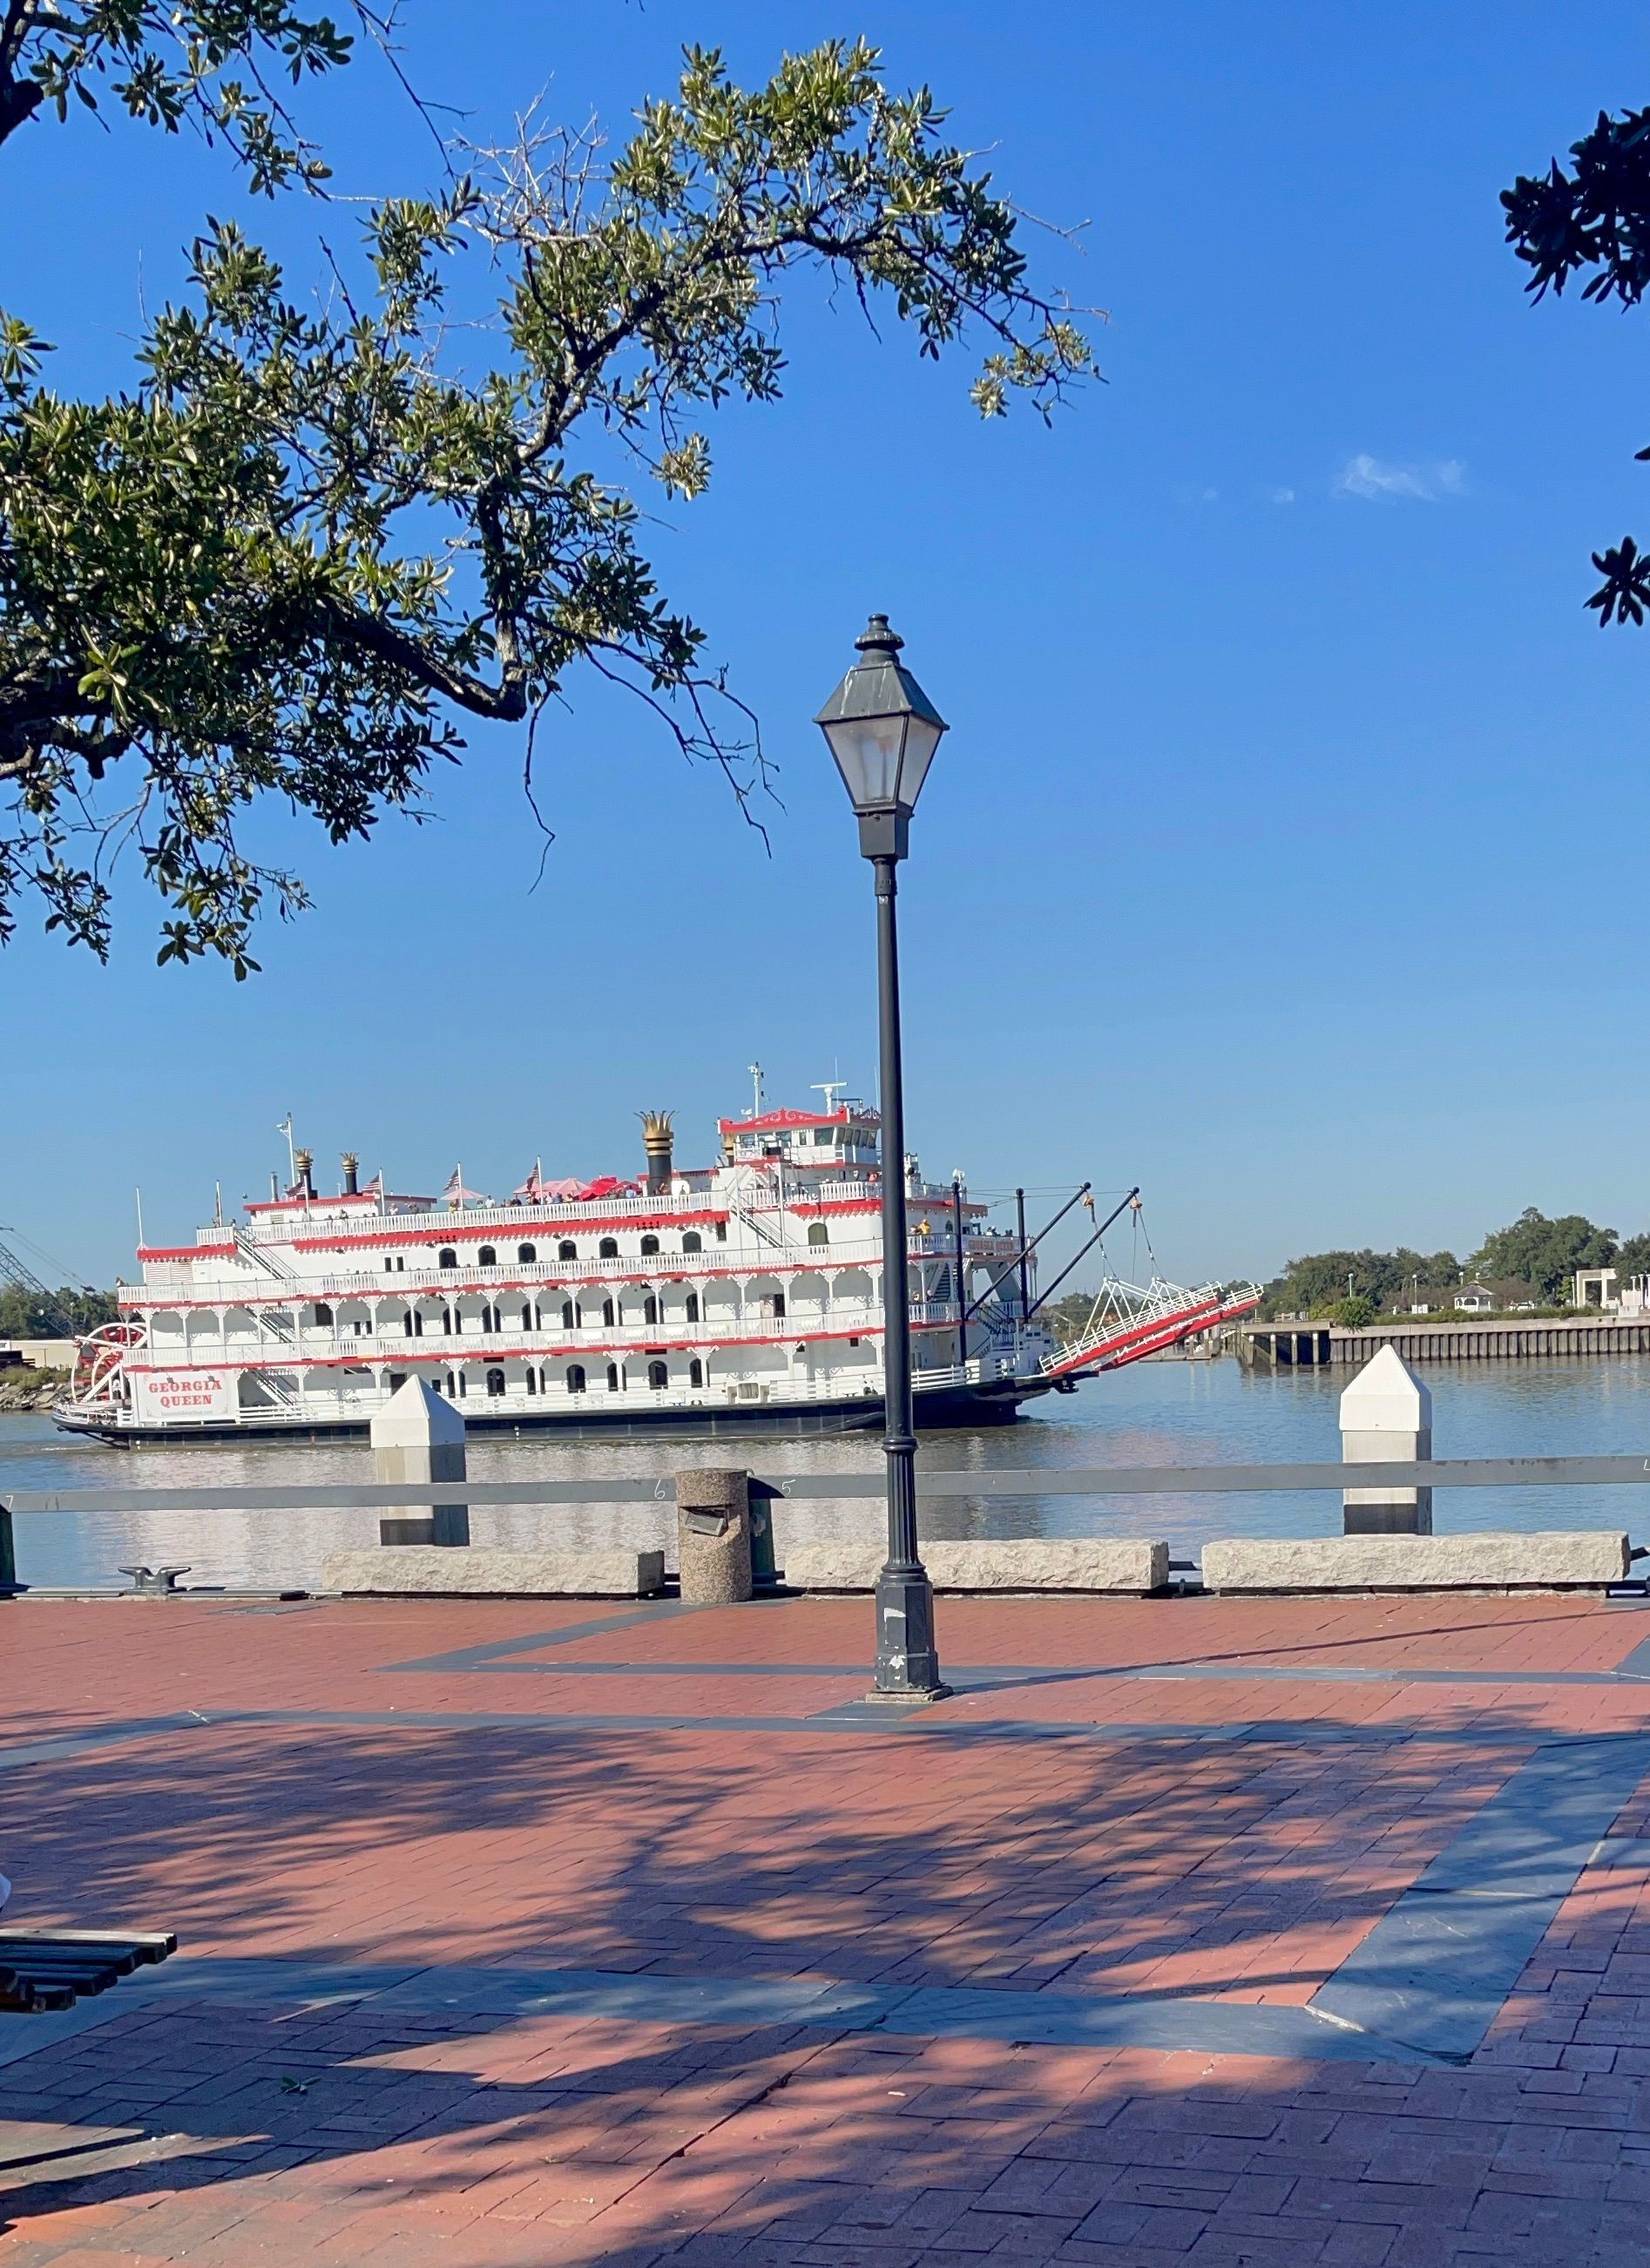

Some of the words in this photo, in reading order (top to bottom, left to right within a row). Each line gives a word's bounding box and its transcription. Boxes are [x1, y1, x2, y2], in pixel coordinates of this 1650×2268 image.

[149, 1380, 222, 1393] GEORGIA
[160, 1395, 212, 1408] QUEEN
[654, 1479, 666, 1500] 6
[781, 1479, 796, 1496] 5
